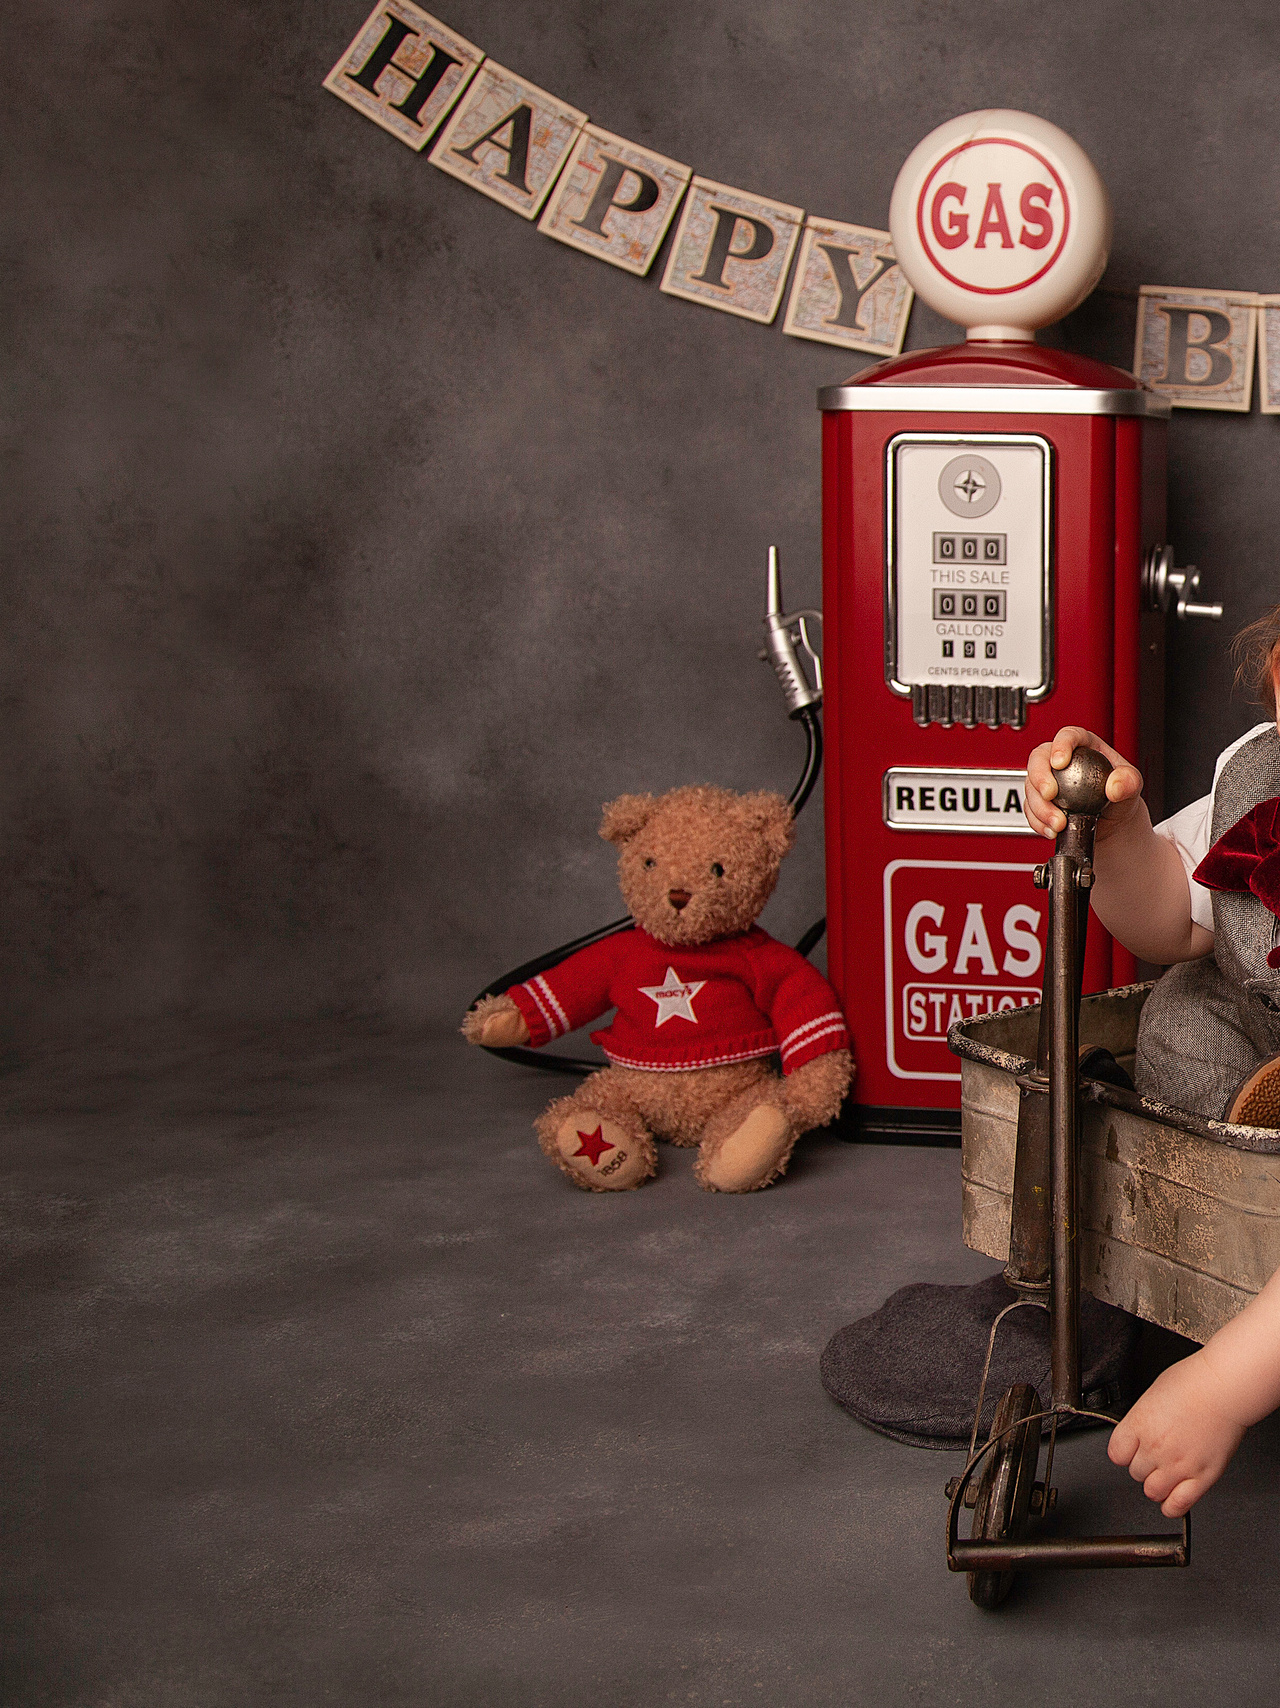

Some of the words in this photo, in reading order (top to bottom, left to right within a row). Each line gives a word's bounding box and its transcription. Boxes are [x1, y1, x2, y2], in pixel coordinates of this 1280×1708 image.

[344, 11, 899, 332] HAPPY
[931, 181, 1054, 250] GAS
[941, 539, 999, 558] 000
[930, 569, 965, 583] THIS
[970, 570, 1010, 584] SALE
[941, 596, 999, 615] 000
[936, 623, 1004, 637] GALLONS
[928, 667, 959, 676] CENTS
[960, 667, 979, 677] PER
[981, 667, 1019, 677] GALLON
[896, 786, 1023, 813] REGULA
[905, 900, 1042, 978] GAS
[655, 985, 692, 998] macy's
[910, 991, 1041, 1033] STAT
[596, 1150, 627, 1177] 1858
